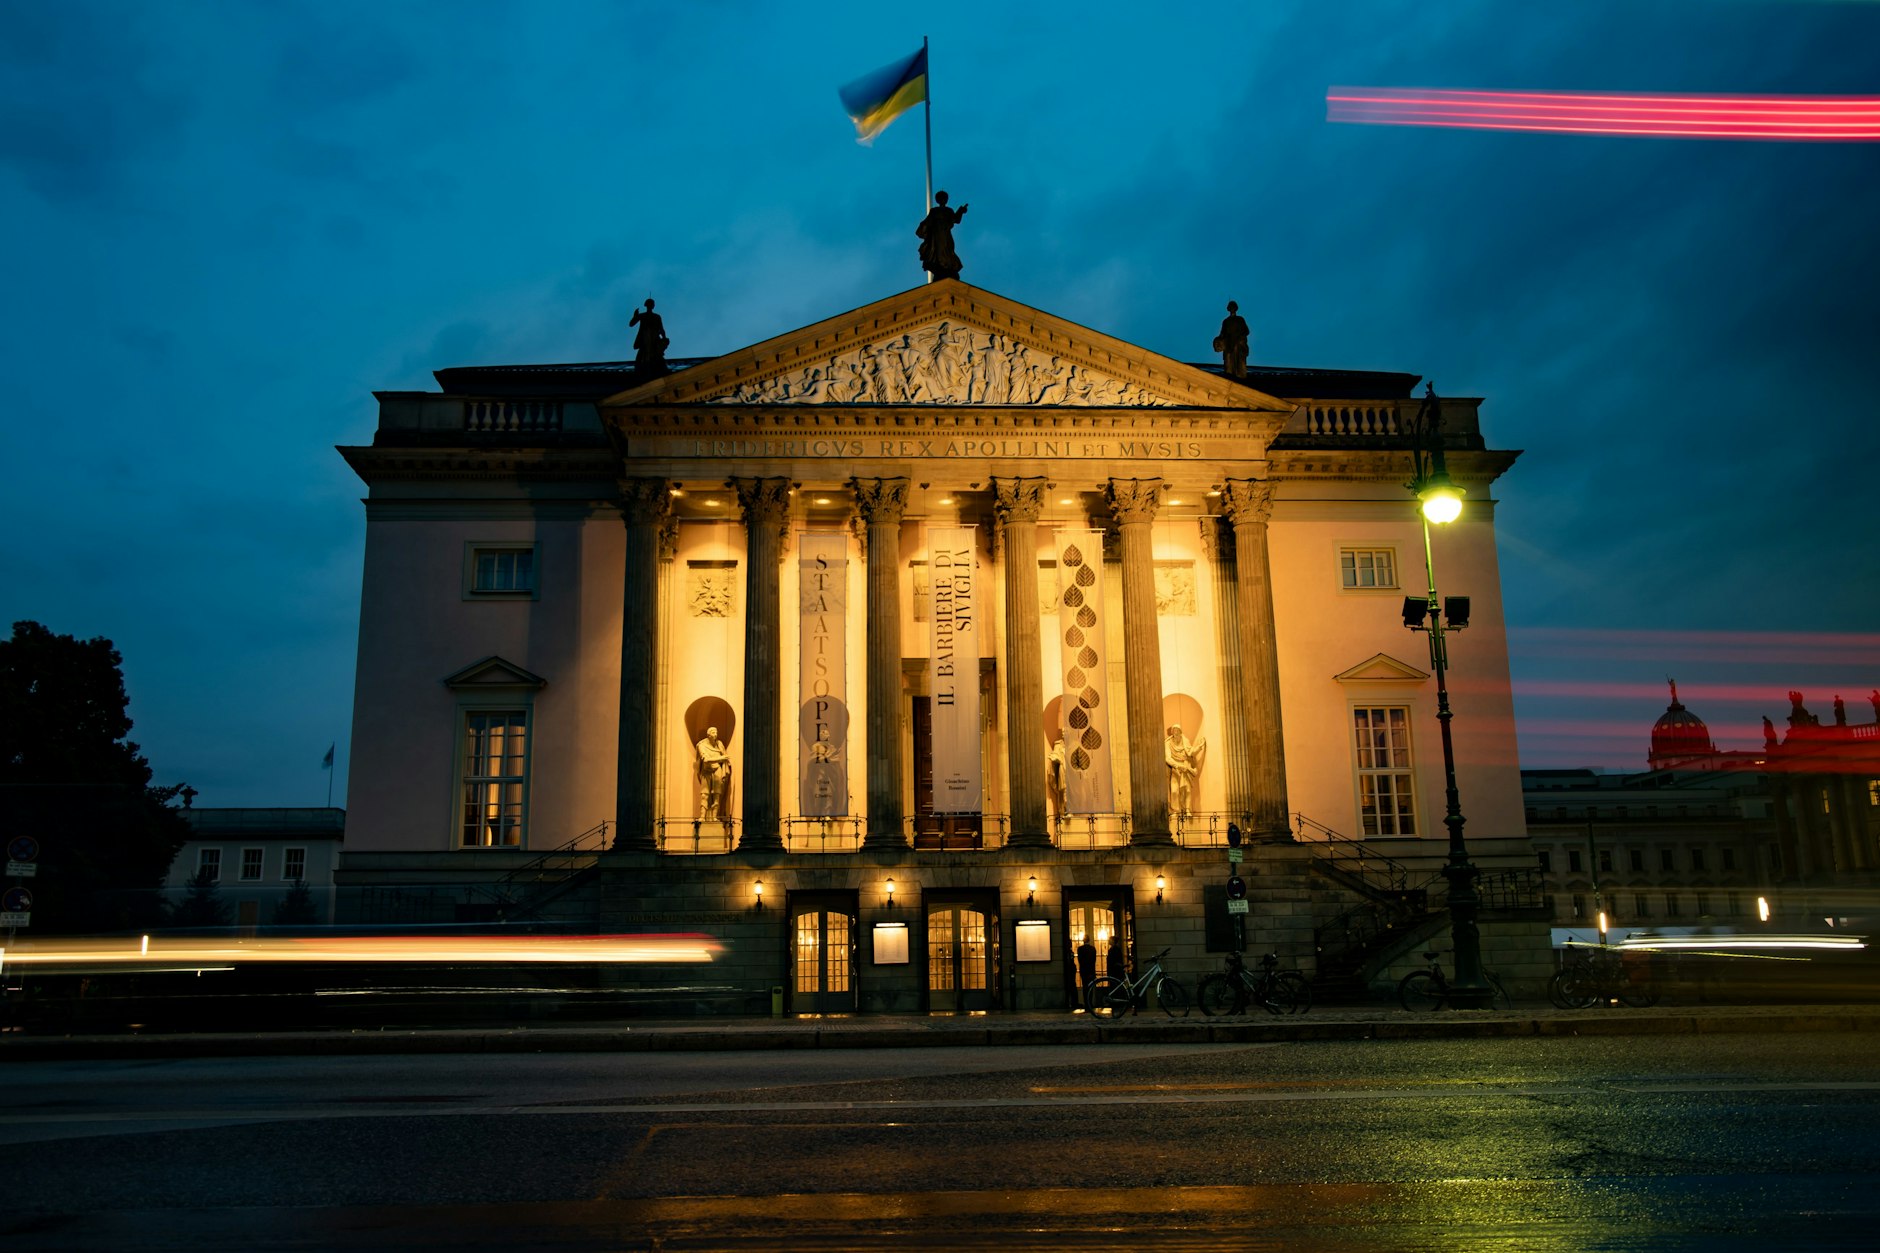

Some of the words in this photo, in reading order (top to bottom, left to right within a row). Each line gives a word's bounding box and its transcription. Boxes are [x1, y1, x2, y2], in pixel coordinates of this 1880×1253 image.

[694, 440, 865, 457] FRIDERICVS
[879, 440, 935, 457] REX
[944, 441, 1071, 457] APOLLINI
[1083, 444, 1109, 457] ET
[1118, 441, 1202, 458] MVSIS
[935, 549, 952, 568] DI
[954, 549, 972, 632] SIVIGLIA
[936, 577, 954, 677] BARBIERE
[813, 553, 829, 764] STAATSOPER
[937, 685, 955, 706] IL
